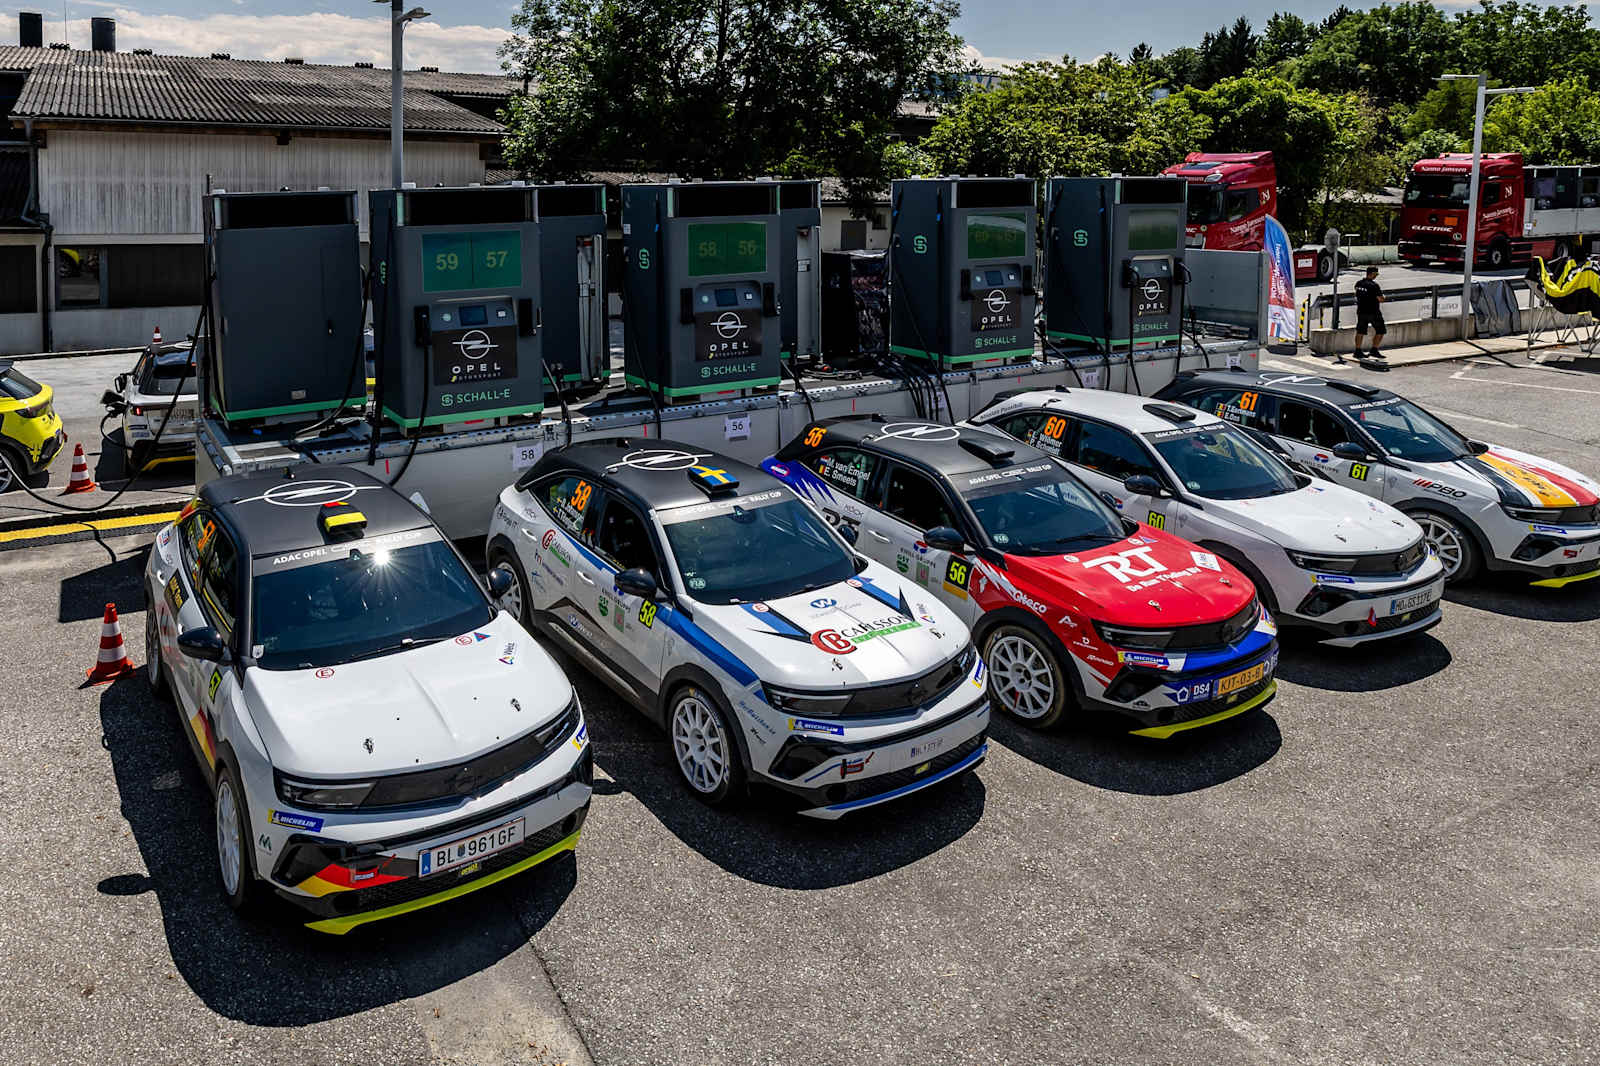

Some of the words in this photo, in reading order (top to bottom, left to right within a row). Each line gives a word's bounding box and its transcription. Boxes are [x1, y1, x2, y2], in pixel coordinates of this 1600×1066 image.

[699, 242, 717, 257] 58
[738, 240, 757, 256] 56
[435, 253, 459, 271] 59
[485, 250, 508, 268] 57
[981, 315, 1012, 324] OPEL
[709, 341, 749, 352] OPEL
[452, 362, 501, 374] OPEL
[713, 362, 757, 375] SCHALL-E
[457, 388, 511, 403] SCHALL-E
[1240, 391, 1259, 411] 61
[732, 421, 744, 431] 56
[1044, 416, 1066, 439] 60
[804, 427, 828, 447] 56
[521, 449, 535, 461] 58
[831, 468, 857, 486] Smeets
[835, 462, 849, 473] van
[847, 465, 871, 480] Empel
[1351, 464, 1367, 480] 61
[571, 480, 592, 511] 58
[1426, 483, 1467, 498] PBO
[1148, 512, 1165, 530] 60
[273, 554, 301, 565] ADAC
[303, 548, 328, 559] OPEL
[1082, 546, 1168, 583] RT
[949, 561, 967, 585] 56
[639, 600, 657, 627] 58
[841, 613, 909, 638] CARLSSON
[1133, 655, 1165, 664] MICHELIN
[1193, 682, 1210, 696] DS4
[280, 815, 317, 828] MICHELIN
[436, 847, 456, 867] BL
